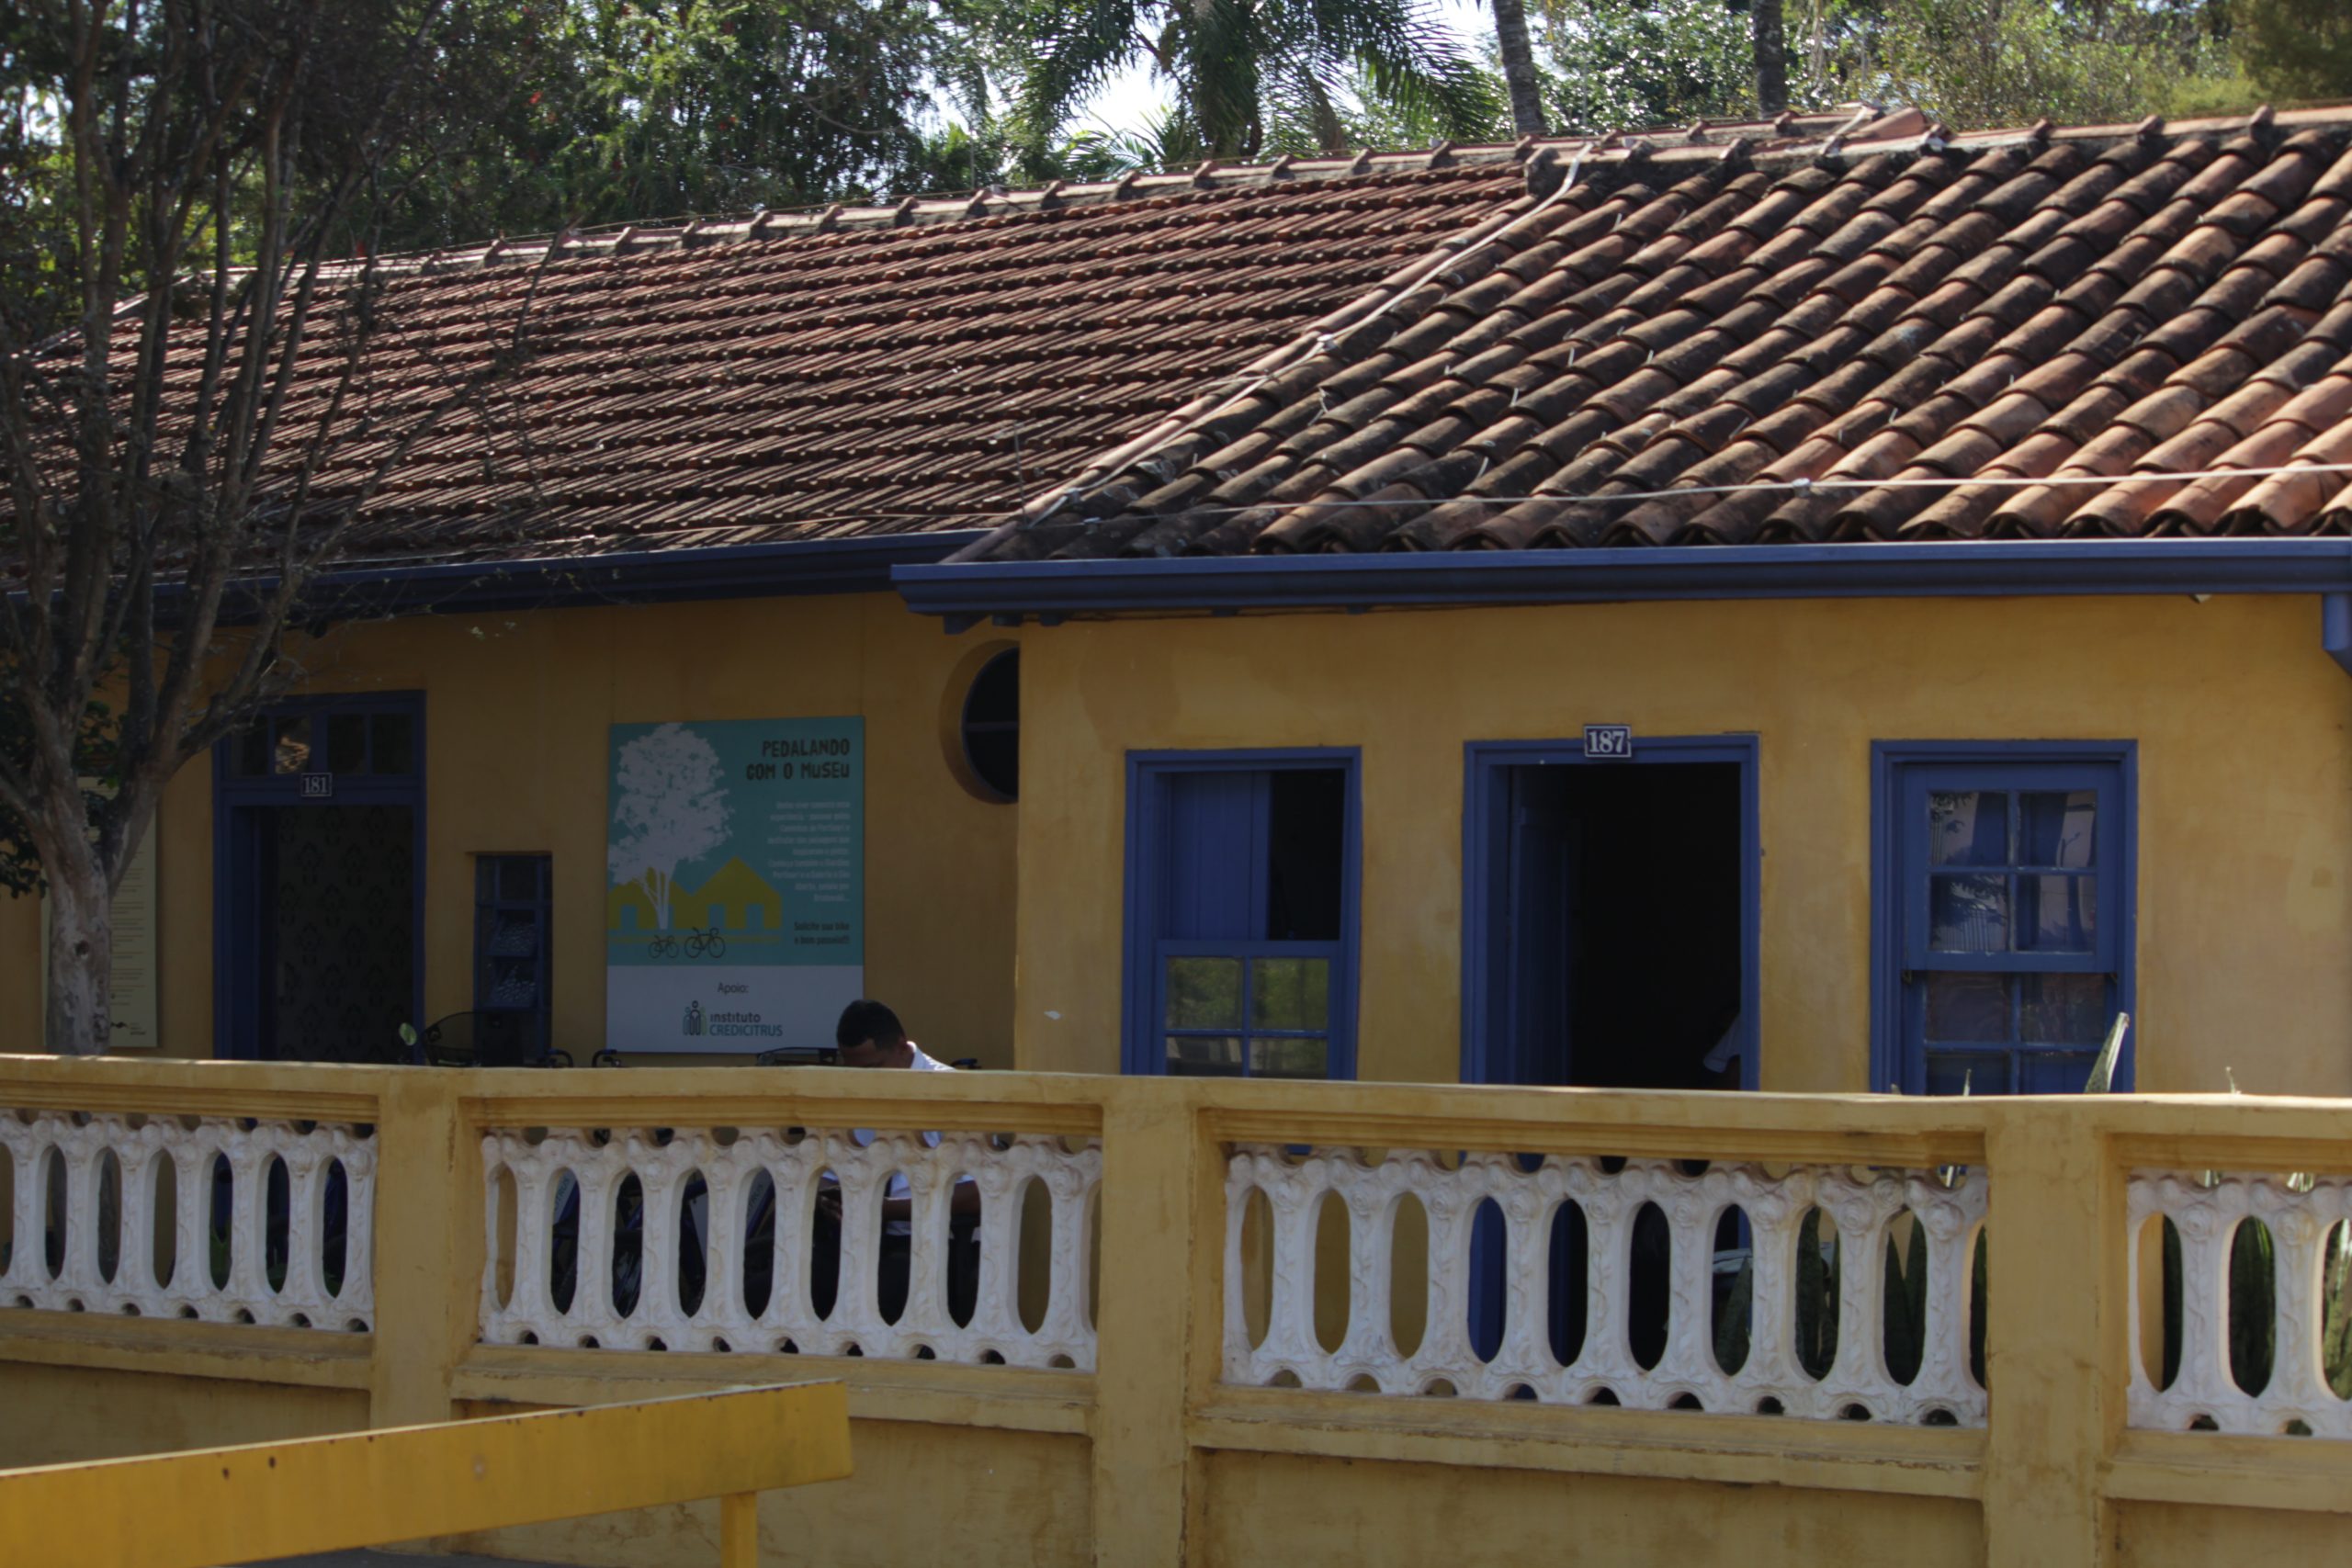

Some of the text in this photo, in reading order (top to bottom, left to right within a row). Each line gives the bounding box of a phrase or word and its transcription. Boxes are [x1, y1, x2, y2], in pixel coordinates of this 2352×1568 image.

[762, 739, 850, 757] PEDALANDO
[1588, 730, 1625, 753] 187
[746, 763, 775, 780] COM
[783, 762, 794, 779] O
[304, 776, 327, 794] 181
[717, 982, 750, 996] Apoio:
[710, 1011, 761, 1022] instituto
[709, 1024, 783, 1036] CREDICITRUS
